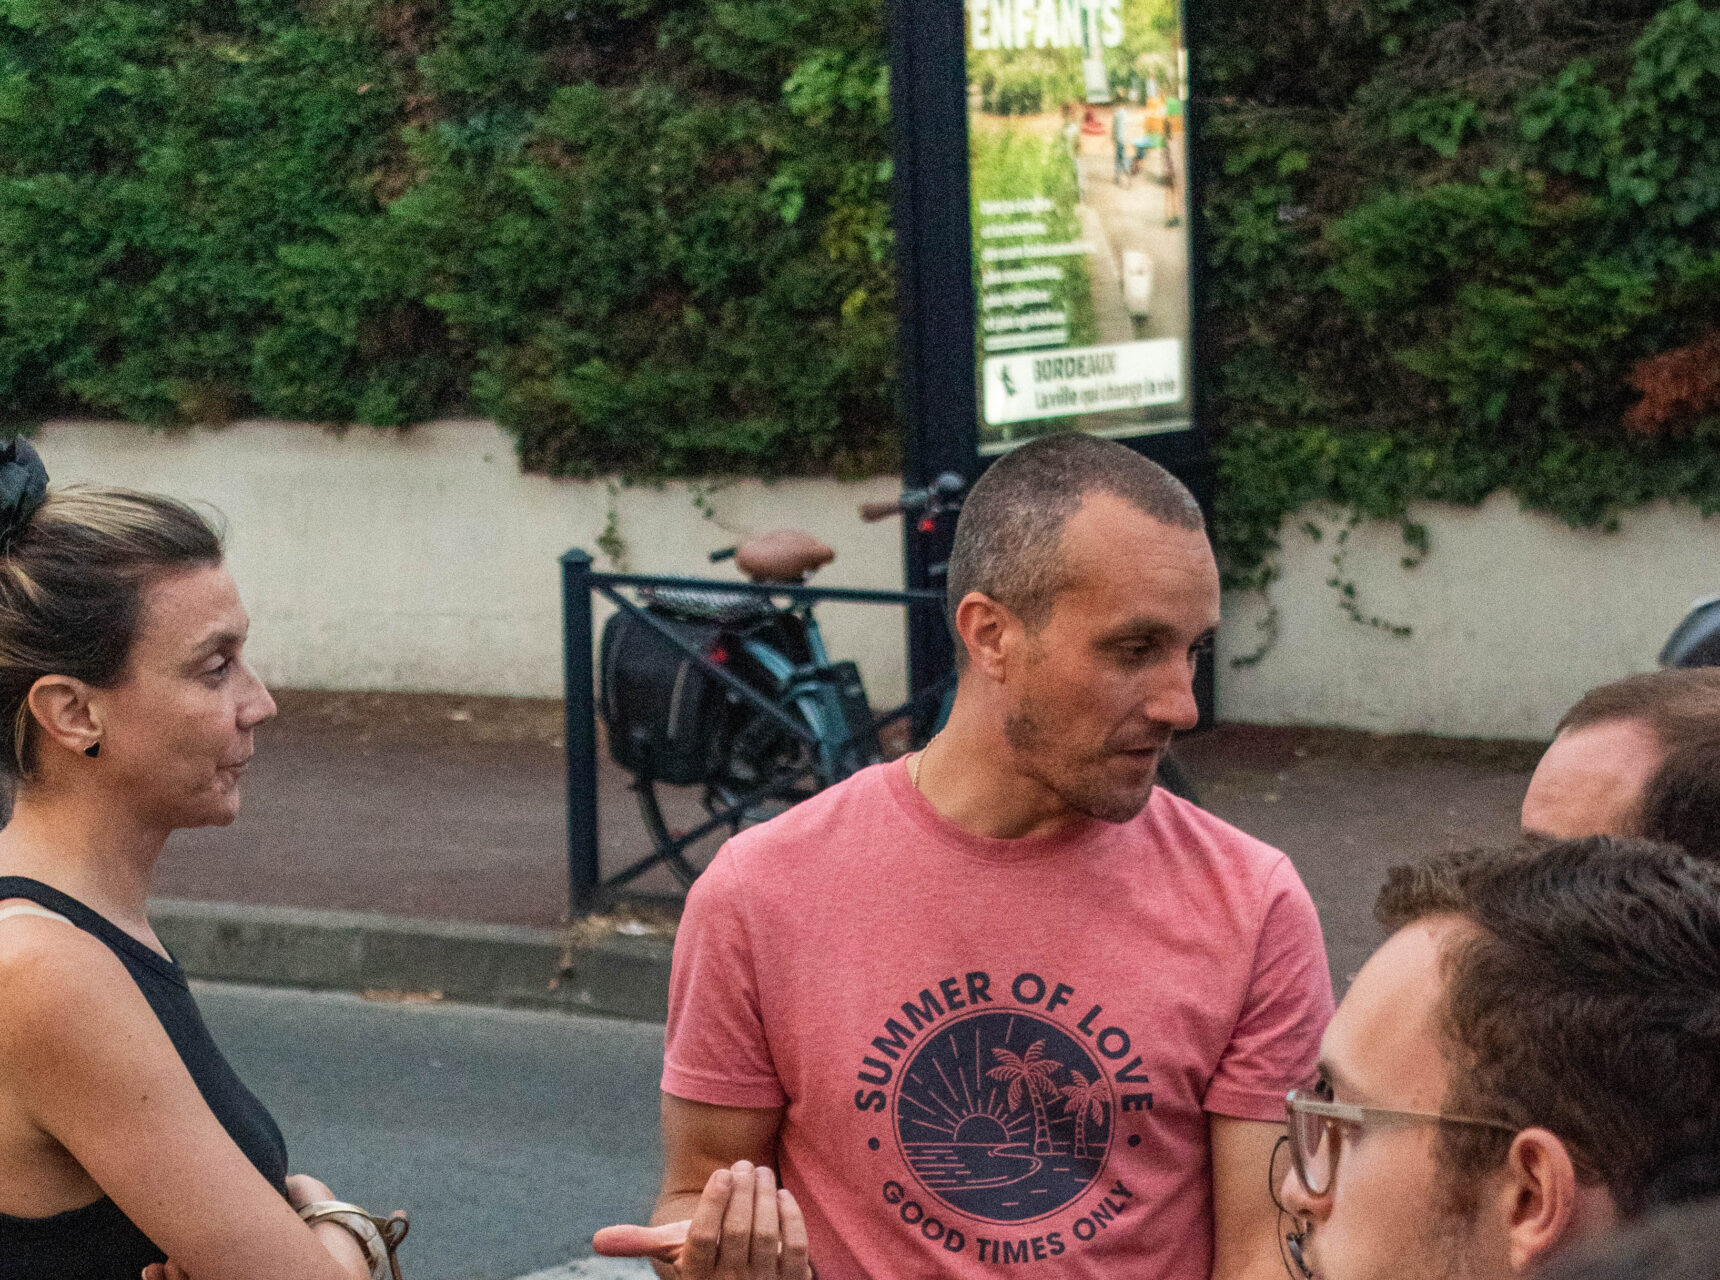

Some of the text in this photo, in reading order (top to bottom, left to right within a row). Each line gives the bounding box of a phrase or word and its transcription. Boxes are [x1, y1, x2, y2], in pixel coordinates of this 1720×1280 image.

[971, 0, 1124, 50] ENFANTS
[1034, 352, 1117, 383] BORDEAUX
[854, 971, 1153, 1113] SUMMER OF LOVE
[882, 1180, 1133, 1264] GOOD TIMES ONLY
